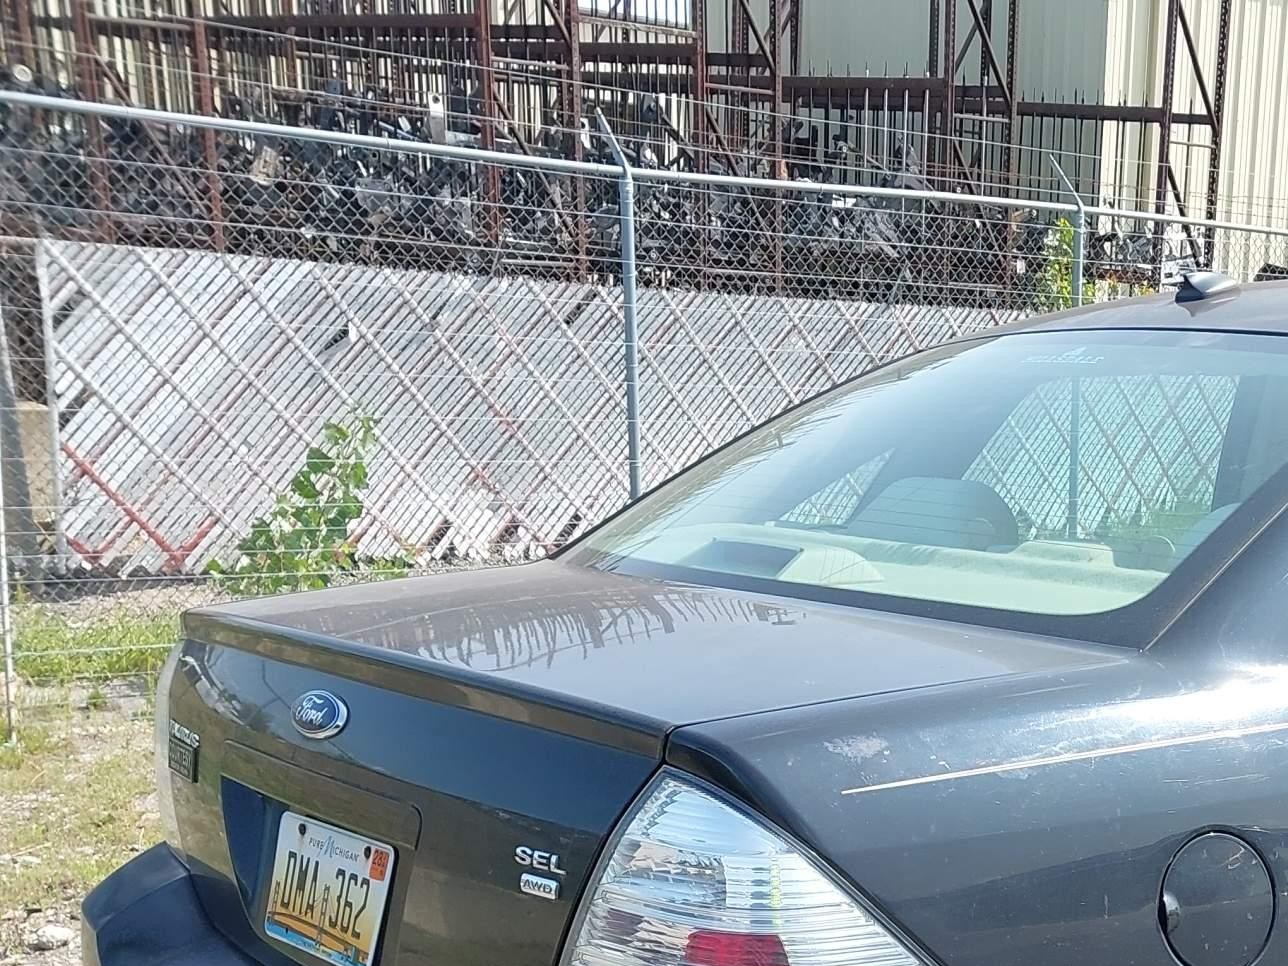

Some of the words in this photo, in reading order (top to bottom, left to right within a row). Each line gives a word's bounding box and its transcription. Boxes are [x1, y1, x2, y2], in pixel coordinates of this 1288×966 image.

[308, 837, 325, 851] PURE
[317, 835, 360, 862] MICHIGAN
[513, 846, 567, 875] SEL
[280, 850, 320, 920] DMA
[328, 867, 371, 941] 362
[522, 879, 553, 894] AWD
